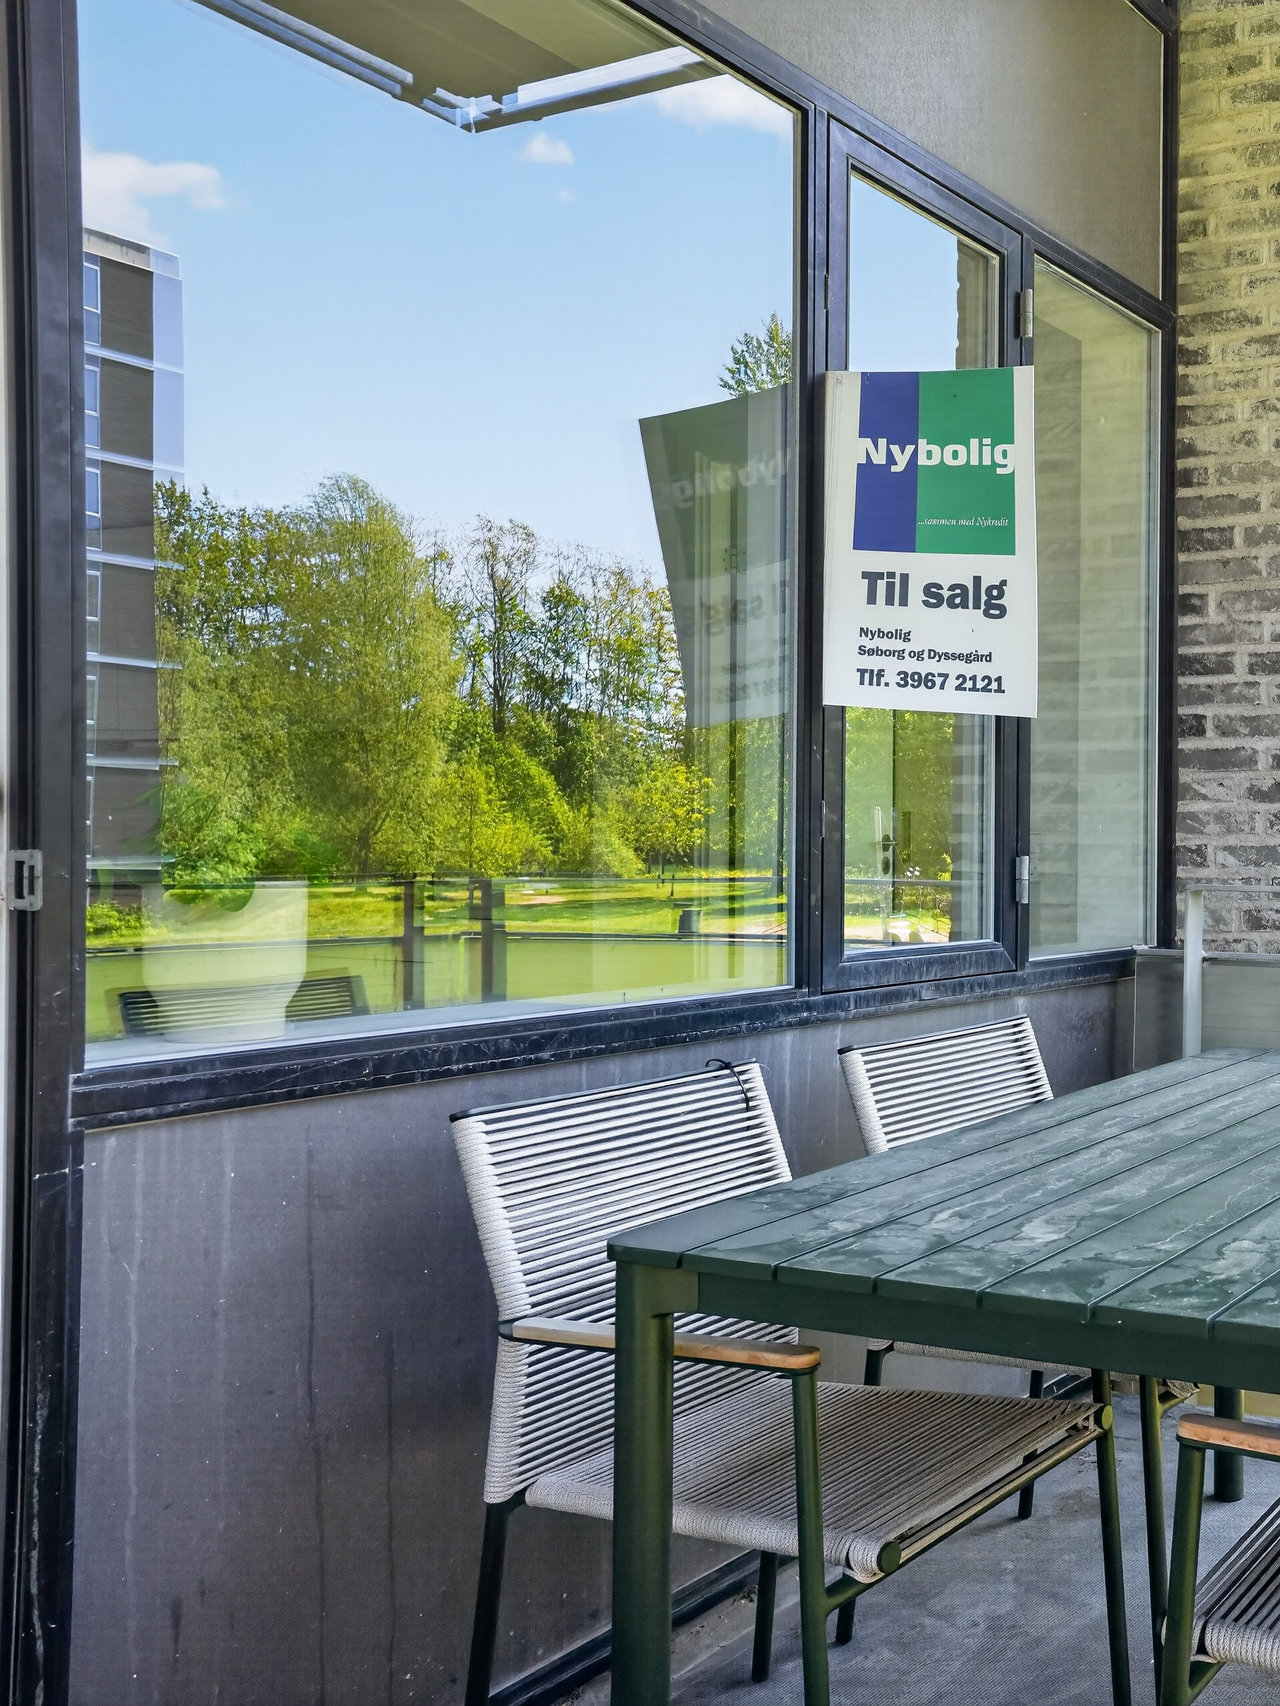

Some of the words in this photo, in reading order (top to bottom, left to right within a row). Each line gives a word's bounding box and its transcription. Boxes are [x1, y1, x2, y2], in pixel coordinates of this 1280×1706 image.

[856, 438, 1015, 475] Nybolig
[958, 516, 975, 527] med
[861, 571, 910, 607] Til
[921, 575, 1008, 620] salg
[859, 627, 912, 643] Nybolig
[857, 644, 906, 661] Søborg
[908, 650, 925, 662] og
[927, 648, 993, 664] Dyssegård
[856, 668, 890, 688] Tlf.
[895, 670, 950, 691] 3967
[954, 673, 1006, 694] 2121
